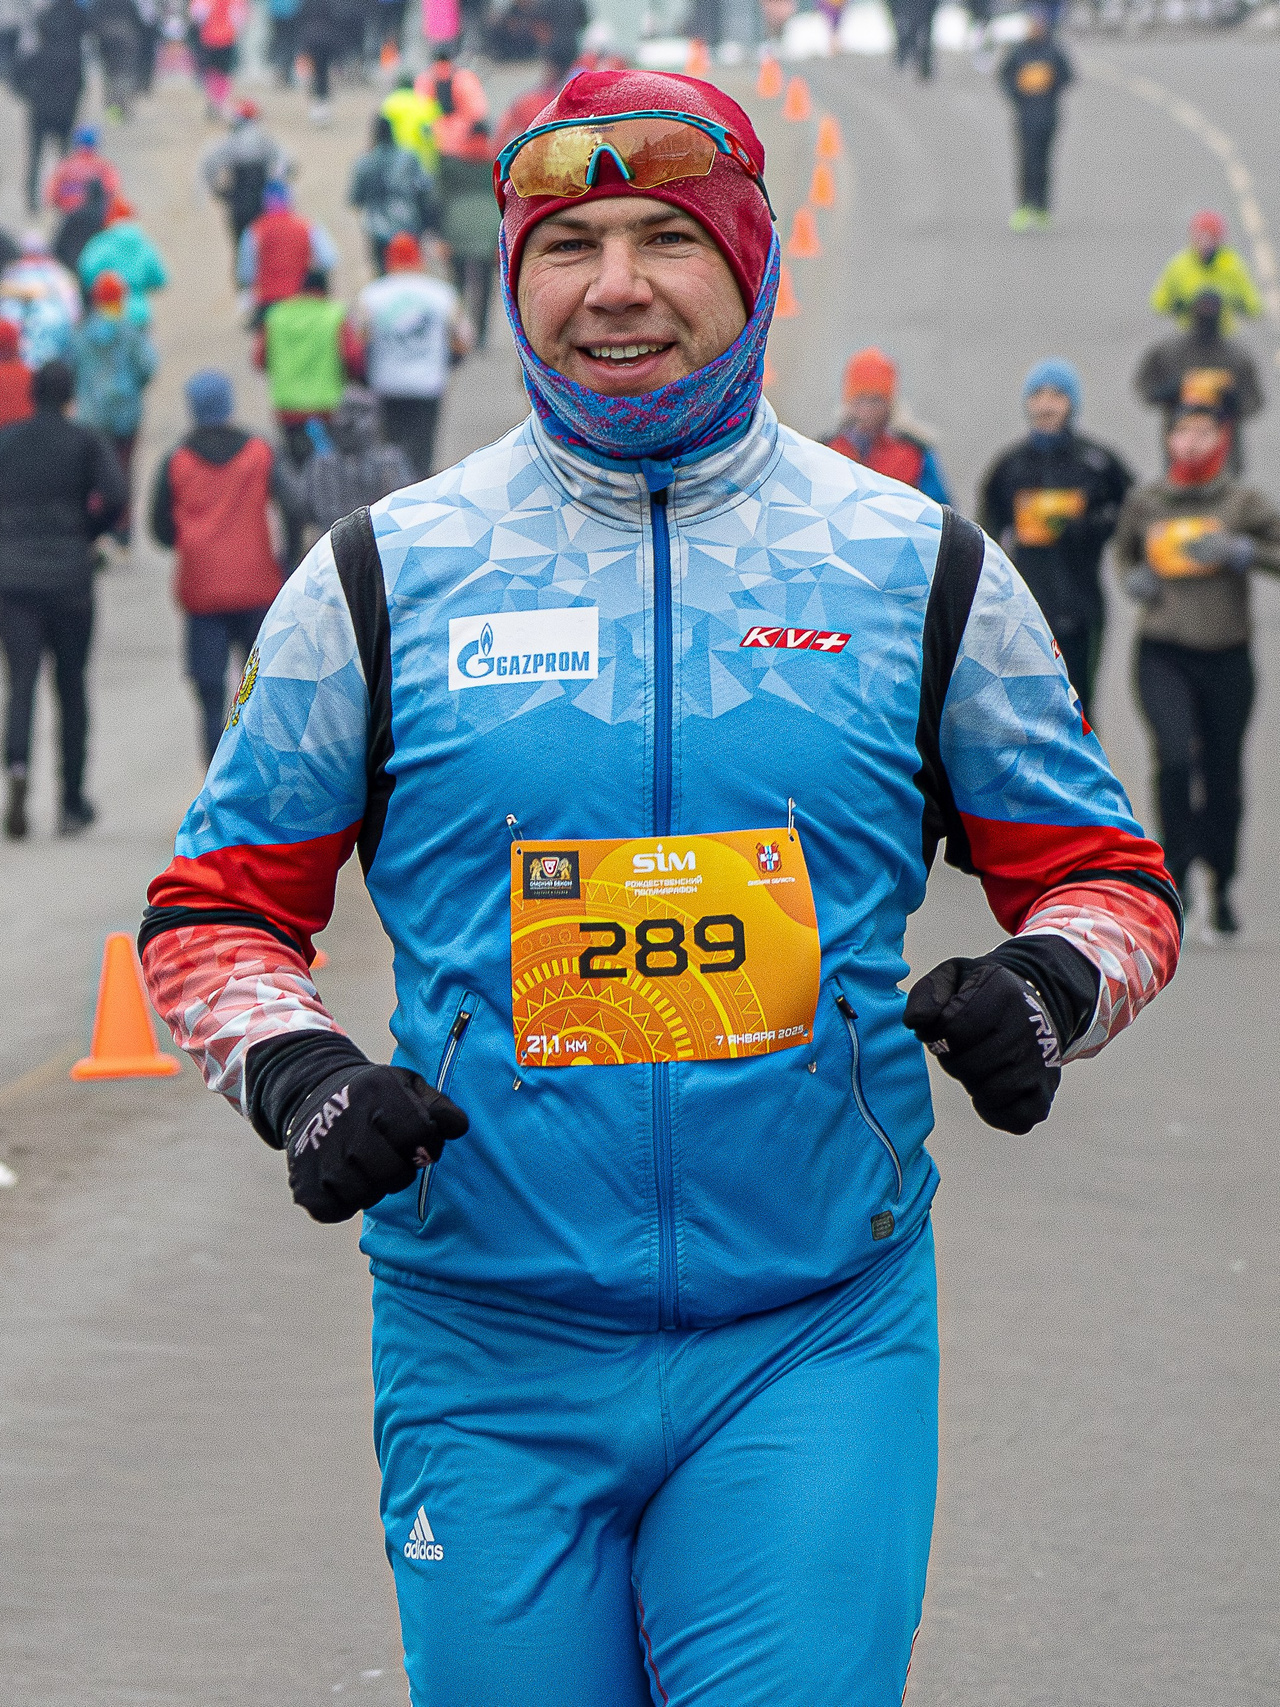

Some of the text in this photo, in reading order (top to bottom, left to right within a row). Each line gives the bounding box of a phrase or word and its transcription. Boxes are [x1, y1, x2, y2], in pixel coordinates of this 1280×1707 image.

[742, 627, 847, 651] KV+
[496, 651, 590, 677] GAZPROM
[578, 913, 747, 980] 289
[714, 1024, 804, 1046] 7 ЯНВАРЯ 2025
[403, 1539, 444, 1561] adidas
